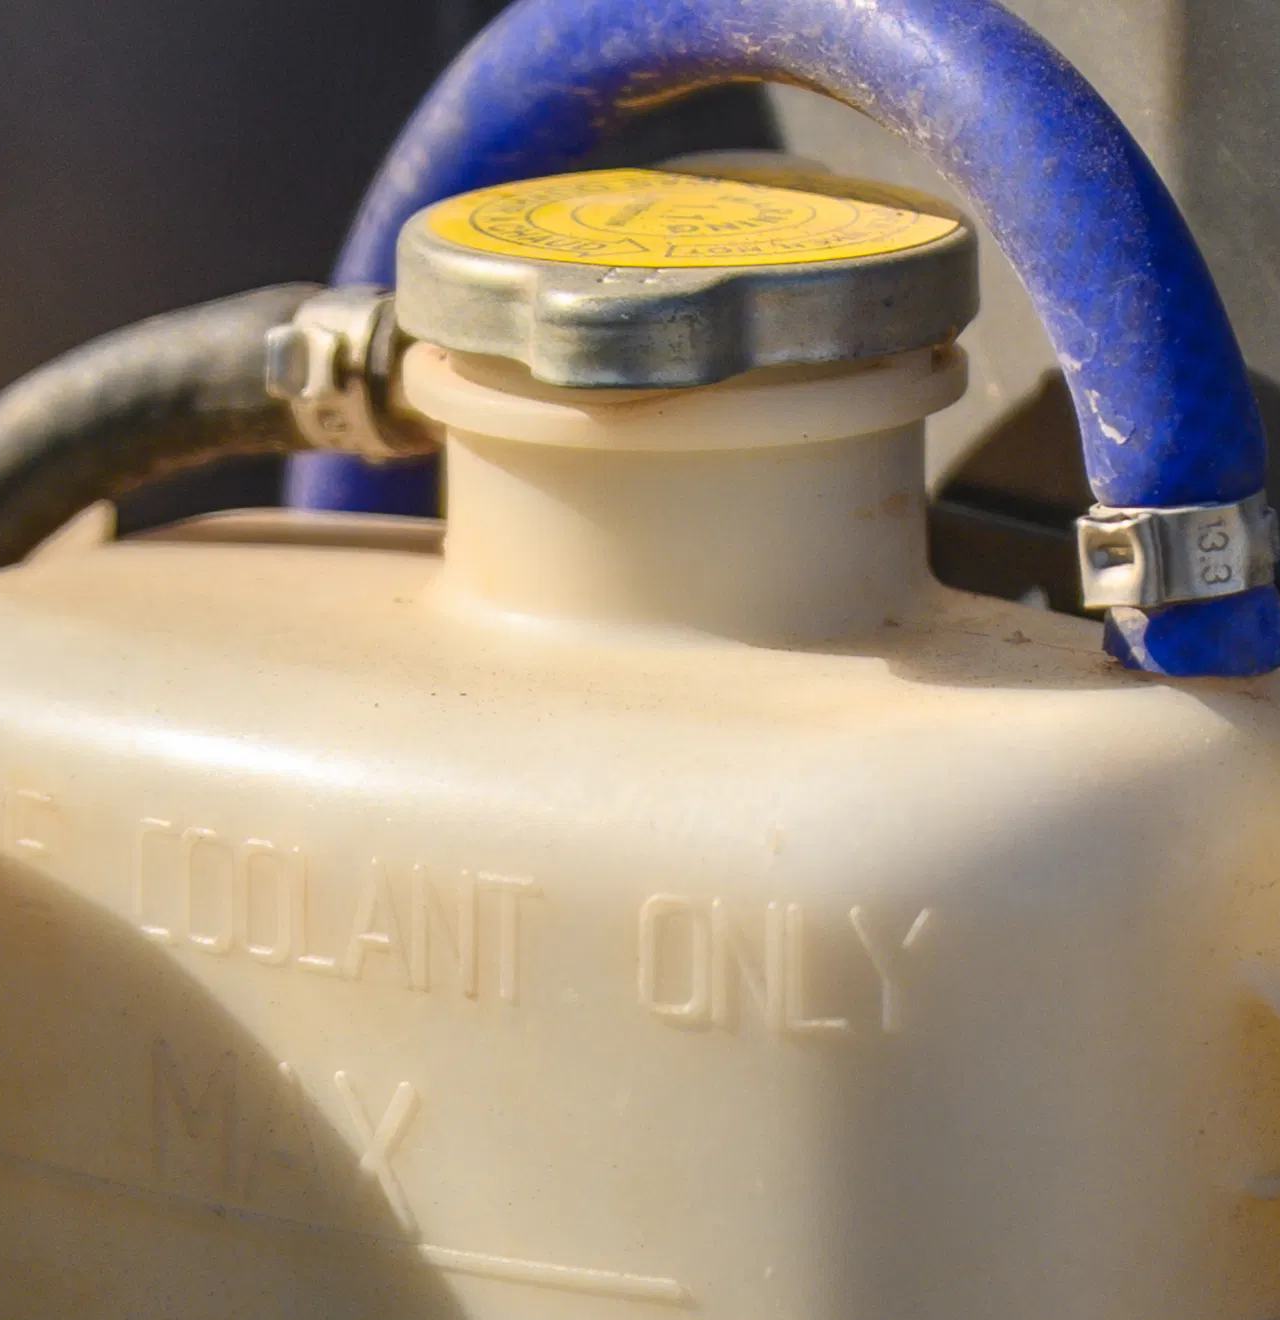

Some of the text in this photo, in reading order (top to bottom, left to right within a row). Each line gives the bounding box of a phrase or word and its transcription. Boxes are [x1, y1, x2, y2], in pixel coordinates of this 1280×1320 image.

[132, 814, 540, 1004] COOLANT
[637, 890, 934, 1036] ONLY
[148, 1036, 422, 1234] MAX
